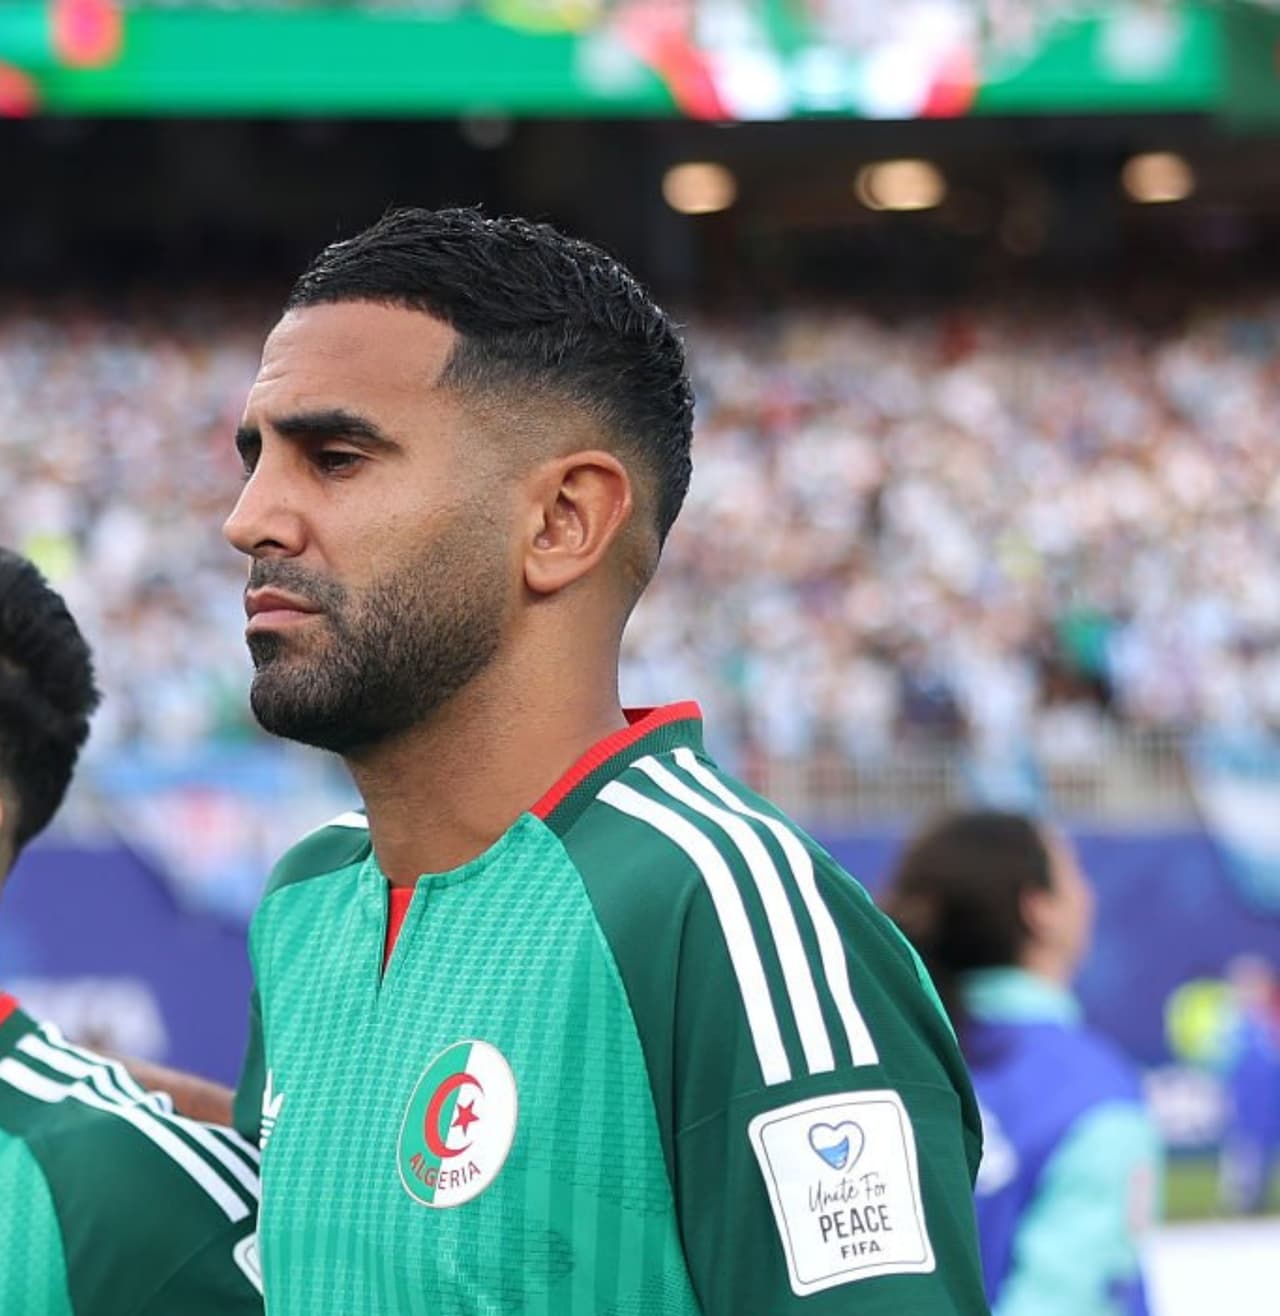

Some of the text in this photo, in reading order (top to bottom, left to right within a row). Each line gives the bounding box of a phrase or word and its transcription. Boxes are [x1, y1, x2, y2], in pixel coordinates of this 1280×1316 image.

[410, 1153, 481, 1189] ALGERIA
[809, 1172, 886, 1212] Unite For
[819, 1205, 892, 1243] PEACE
[840, 1240, 882, 1259] FIFA
